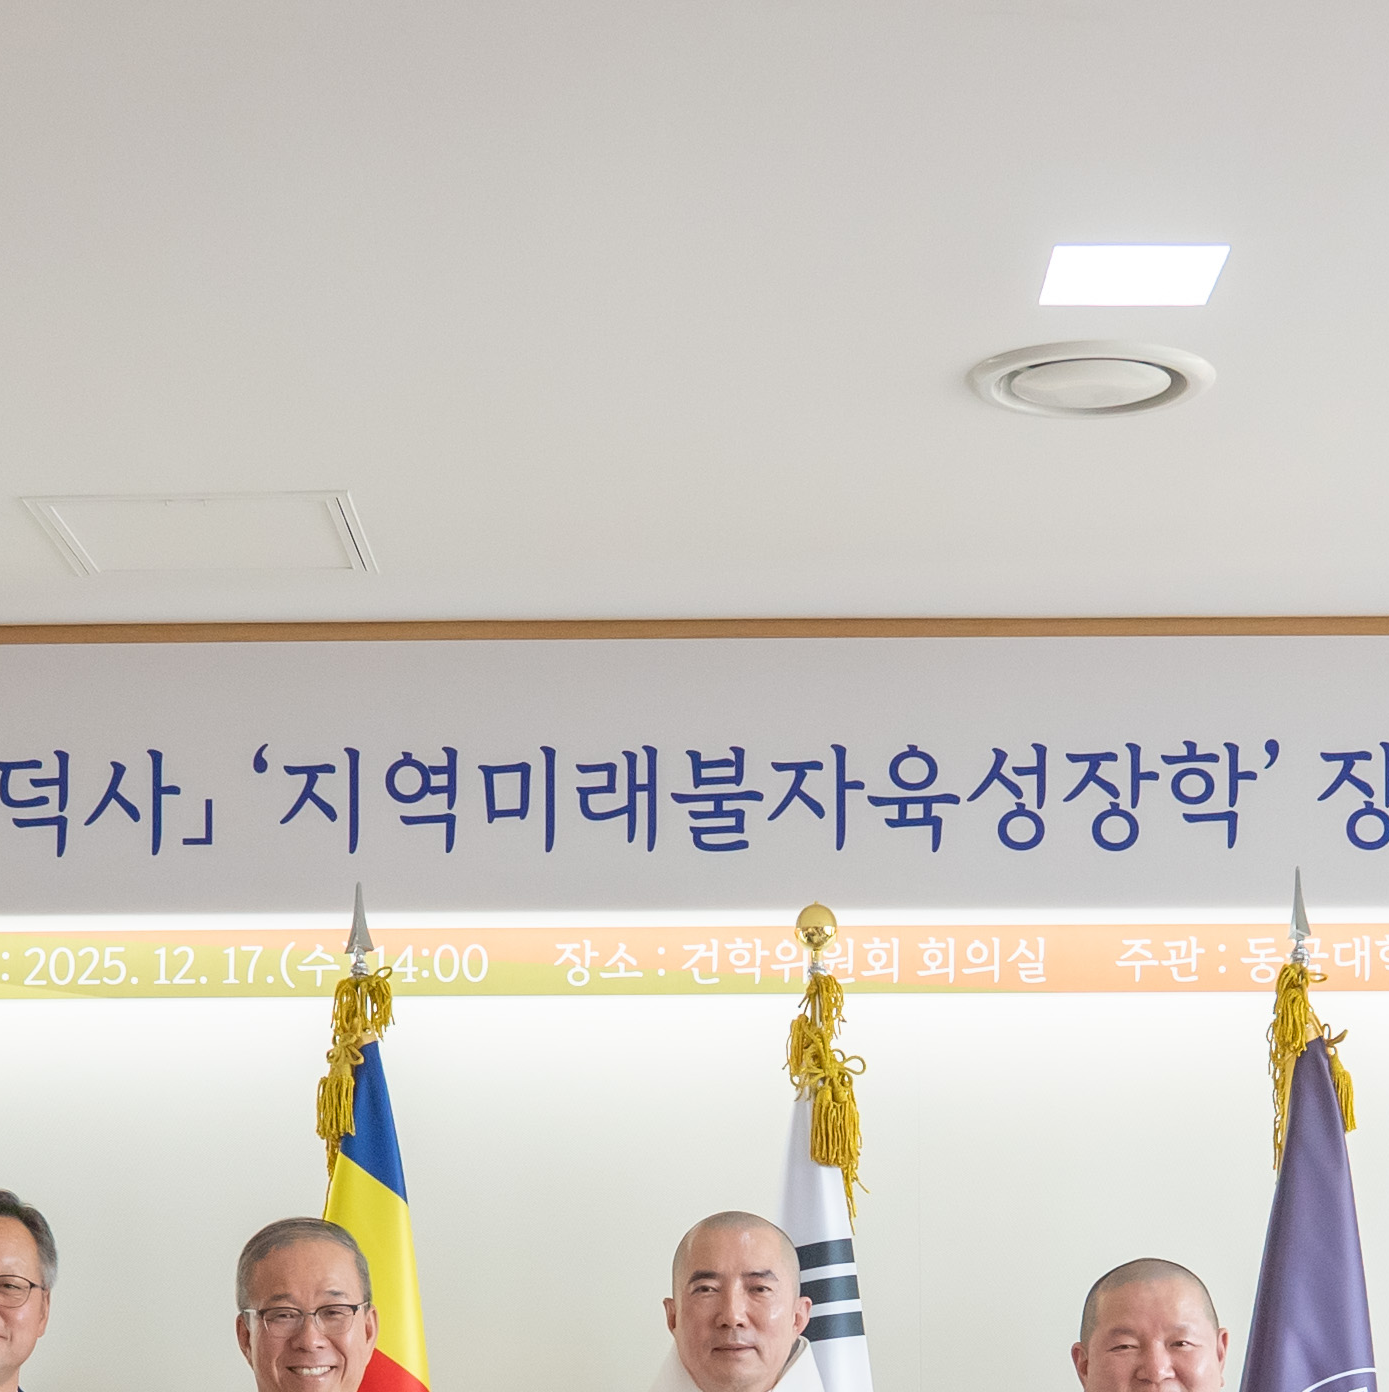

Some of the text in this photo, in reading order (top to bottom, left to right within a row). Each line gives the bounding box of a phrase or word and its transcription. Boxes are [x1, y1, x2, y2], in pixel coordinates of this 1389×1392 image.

[23, 945, 140, 985] 2025.
[152, 945, 209, 984] 12.
[373, 943, 489, 984] 14:00
[553, 939, 644, 987] 장소
[680, 937, 901, 985] 건학위원회
[916, 936, 1047, 983] 회의실
[1114, 935, 1206, 983] 주관
